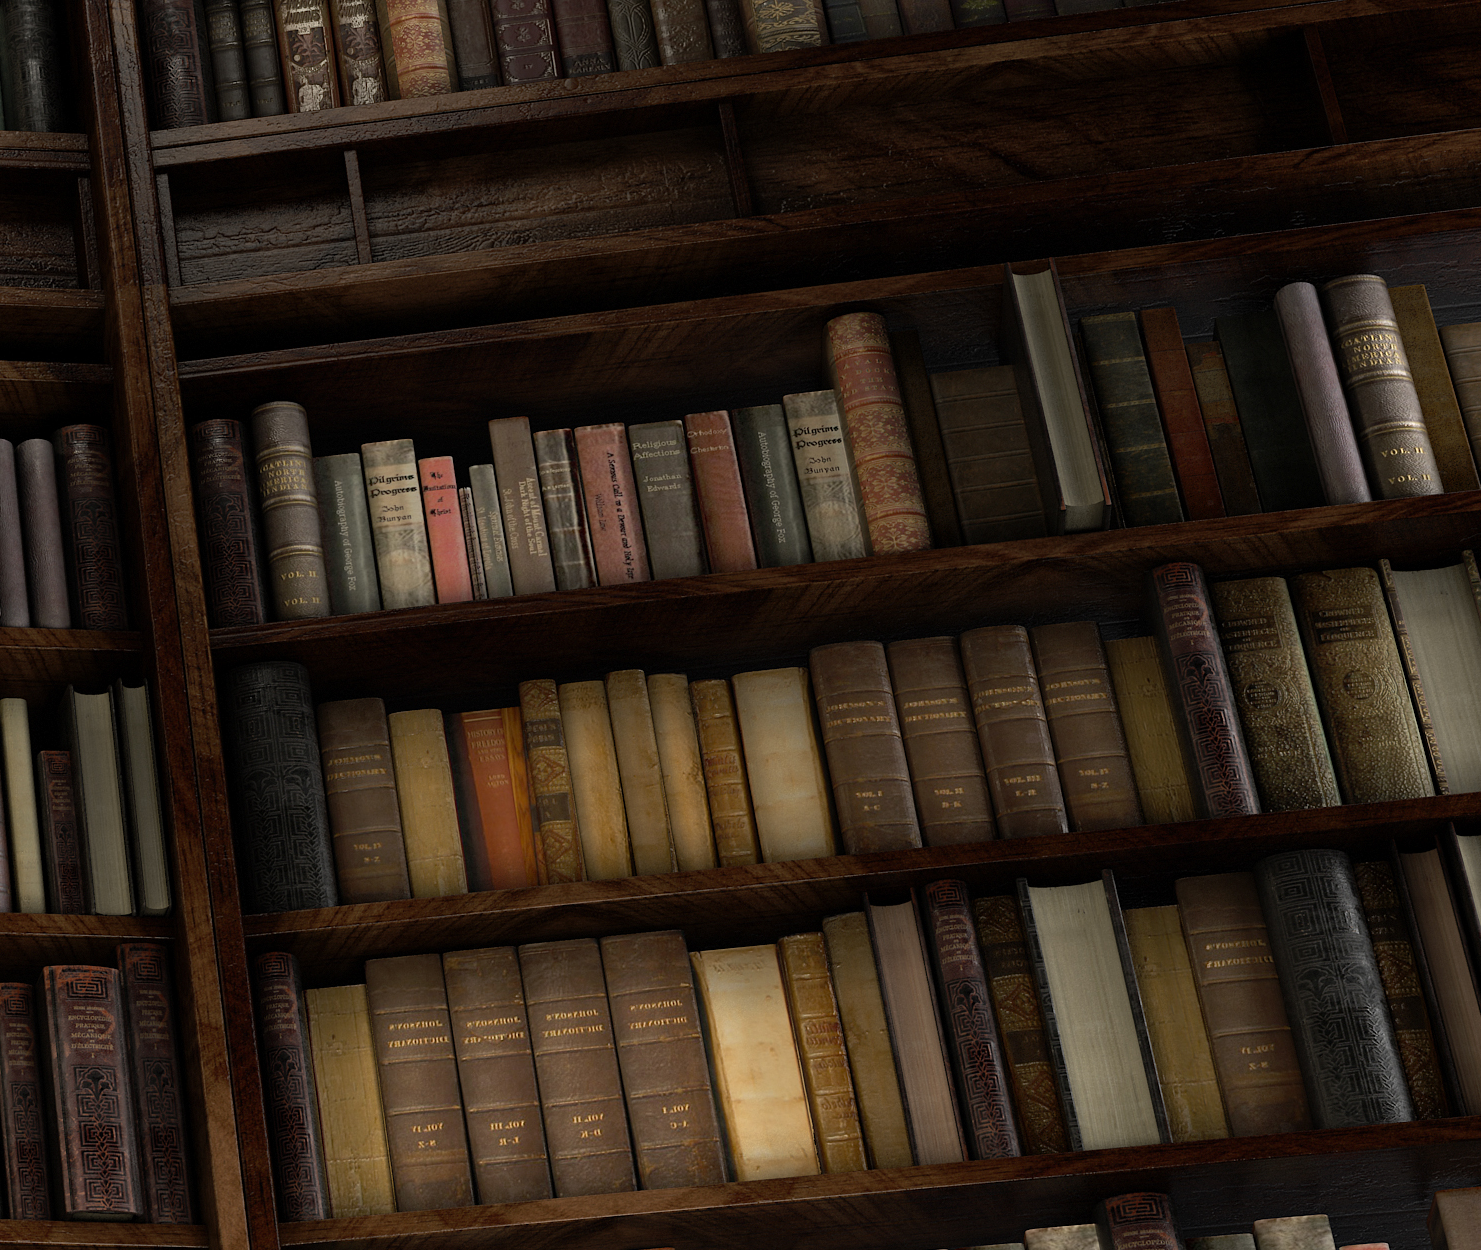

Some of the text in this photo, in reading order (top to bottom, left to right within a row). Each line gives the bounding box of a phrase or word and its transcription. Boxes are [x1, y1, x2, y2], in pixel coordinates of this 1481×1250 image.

[632, 438, 677, 450] Religious
[633, 449, 681, 460] Affections
[368, 473, 415, 486] Pilgrims
[643, 473, 682, 483] Jonathan
[371, 485, 418, 498] Progress
[647, 482, 681, 493] Edwards
[757, 431, 776, 489] Autobiography
[771, 498, 783, 527] George
[777, 528, 786, 544] Fox
